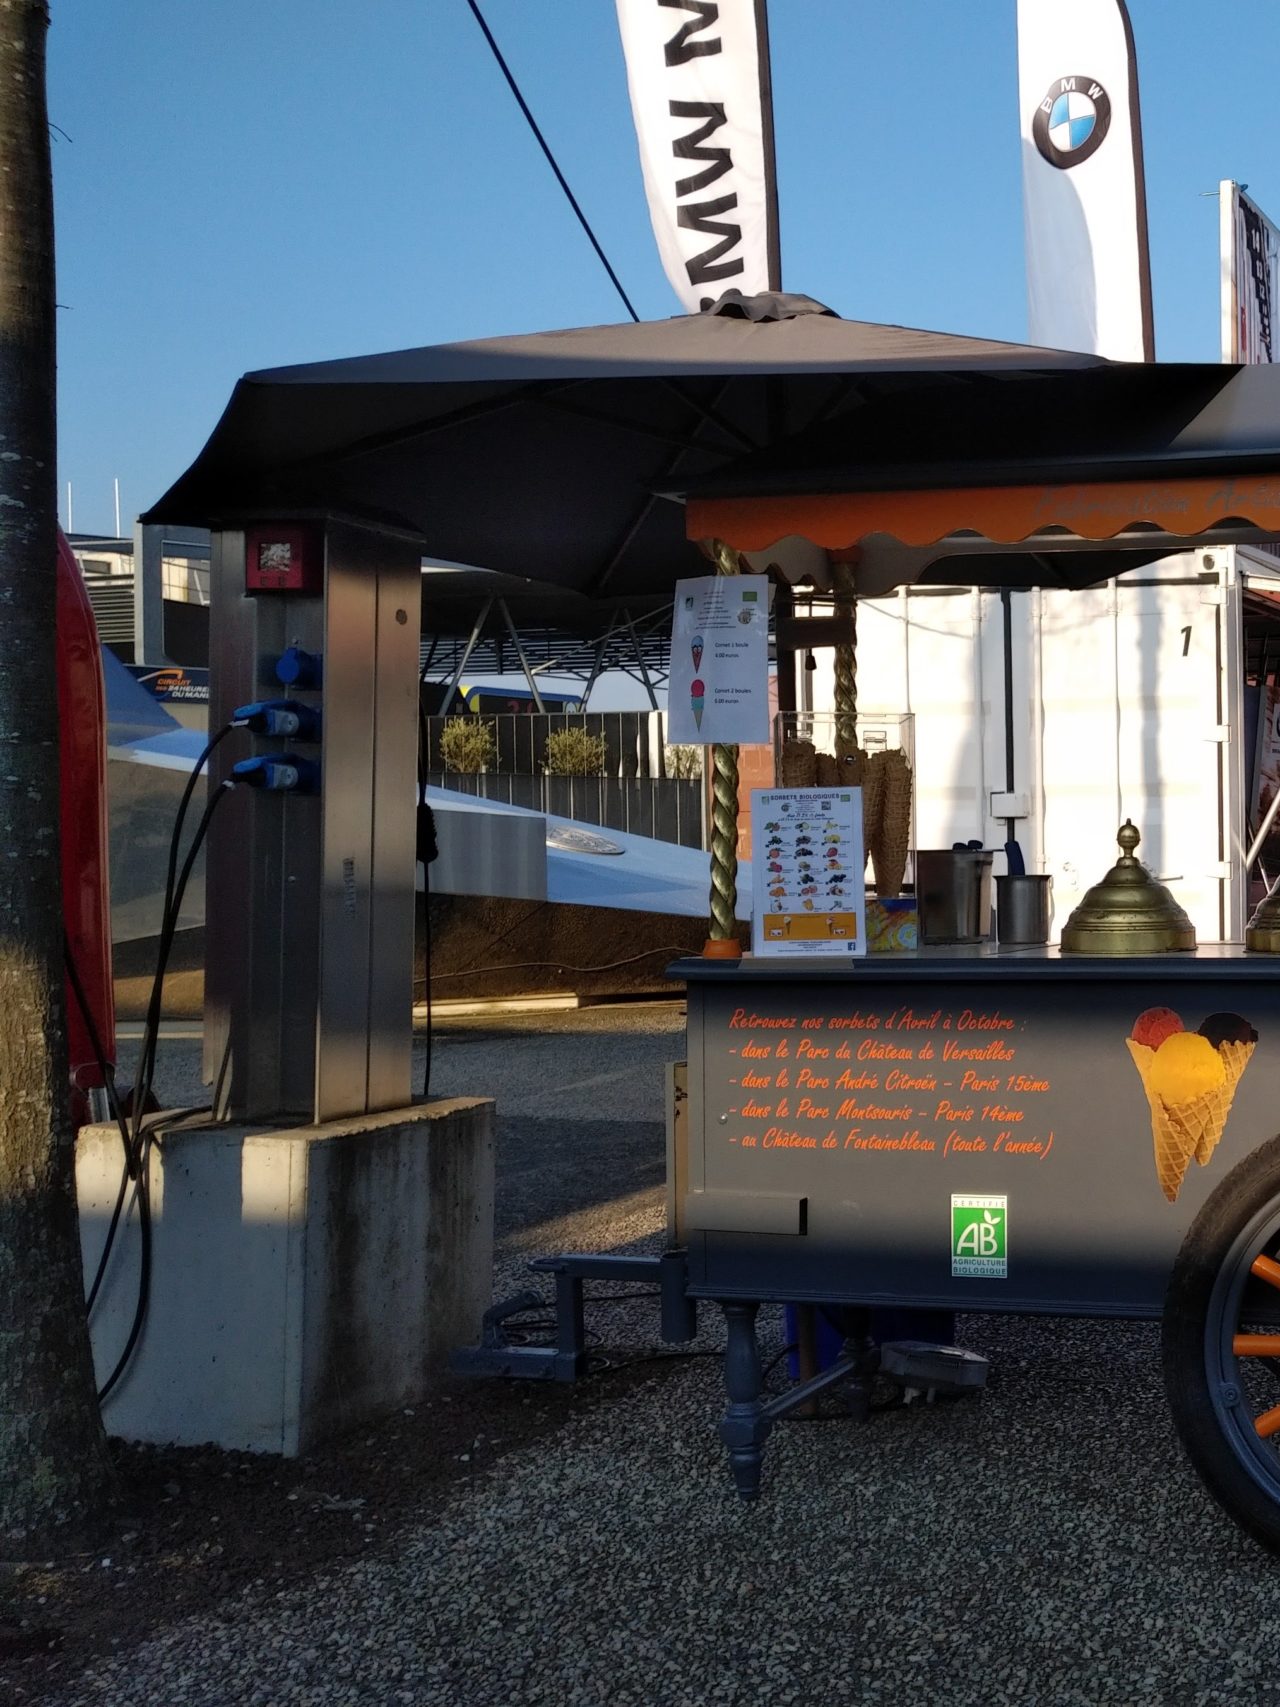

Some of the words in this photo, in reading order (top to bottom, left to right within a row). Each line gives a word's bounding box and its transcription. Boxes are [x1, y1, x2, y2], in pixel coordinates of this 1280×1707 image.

[1180, 625, 1193, 657] 1
[729, 1009, 796, 1028] Retrouvez
[801, 1017, 823, 1030] nos
[828, 1012, 880, 1031] sorbets
[884, 1006, 939, 1031] d'Avril
[943, 1013, 952, 1030] à
[957, 1011, 1014, 1031] Octobre
[740, 1040, 772, 1059] dans
[774, 1039, 790, 1060] le
[795, 1038, 831, 1060] Parc
[834, 1041, 852, 1060] du
[856, 1038, 912, 1062] Château
[918, 1040, 936, 1062] de
[941, 1040, 1016, 1062] Versailles
[740, 1070, 772, 1089] dans
[774, 1068, 790, 1089] le
[795, 1067, 831, 1090] Parc
[835, 1067, 880, 1091] André
[884, 1067, 938, 1093] Citroën
[960, 1068, 1001, 1093] Paris
[1005, 1074, 1051, 1093] 15ème
[740, 1099, 772, 1118] dans
[774, 1099, 790, 1118] le
[795, 1098, 831, 1120] Parc
[835, 1097, 913, 1122] Montsouris
[933, 1098, 975, 1123] Paris
[980, 1104, 1025, 1124] 14ème
[740, 1136, 758, 1148] au
[761, 1127, 819, 1149] Château
[821, 1130, 839, 1150] de
[843, 1126, 937, 1152] Fontainebleau
[941, 1129, 989, 1158] (toute
[993, 1130, 1055, 1159] l'année)
[956, 1222, 998, 1256] AB
[953, 1258, 1006, 1267] AGRICULTURE
[953, 1266, 1006, 1275] BIOLOGIQUE
